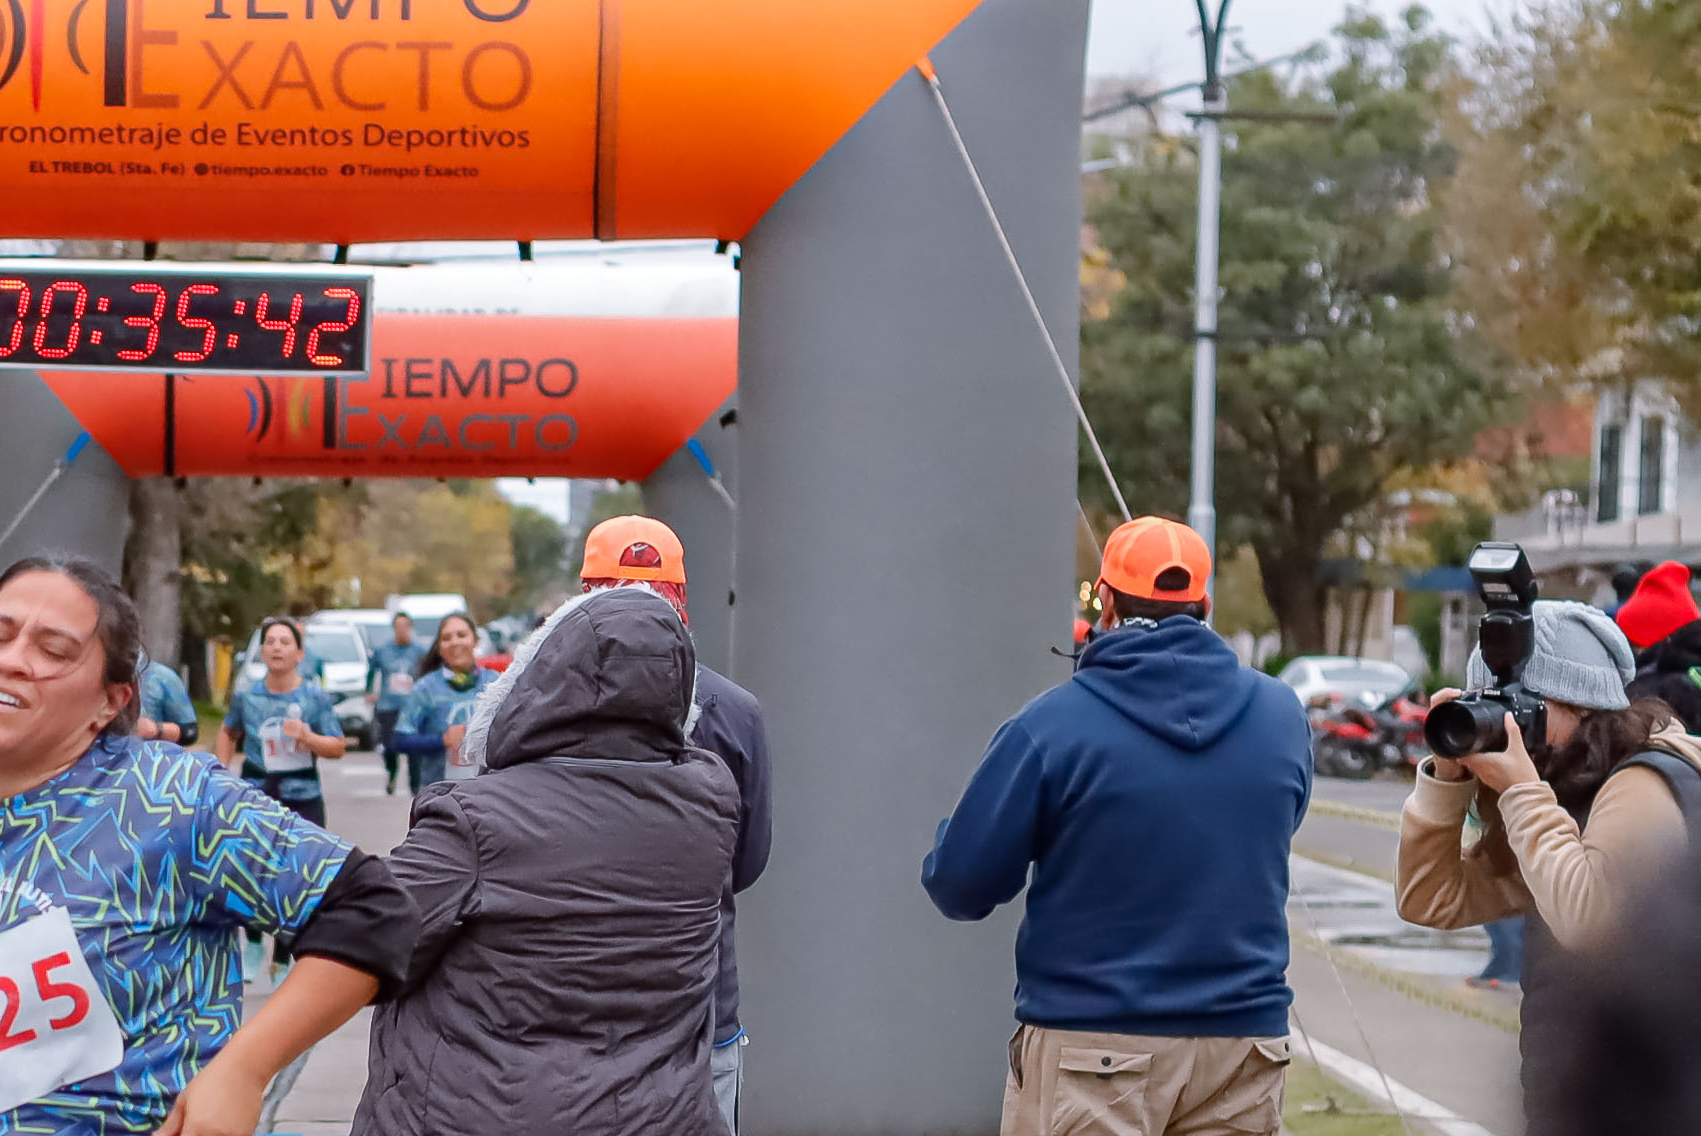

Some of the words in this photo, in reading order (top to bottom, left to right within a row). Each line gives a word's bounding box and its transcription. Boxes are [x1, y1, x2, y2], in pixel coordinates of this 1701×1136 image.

[189, 121, 228, 146] de
[237, 122, 354, 147] Eventos
[363, 122, 531, 152] Deportivos
[29, 161, 48, 174] EL
[52, 161, 114, 175] TREBOL
[120, 162, 157, 177] (Sta.
[161, 162, 186, 177] Fe)
[211, 164, 329, 179] tiempo.exacto
[359, 163, 420, 179] Tiempo
[425, 164, 480, 178] Exacto
